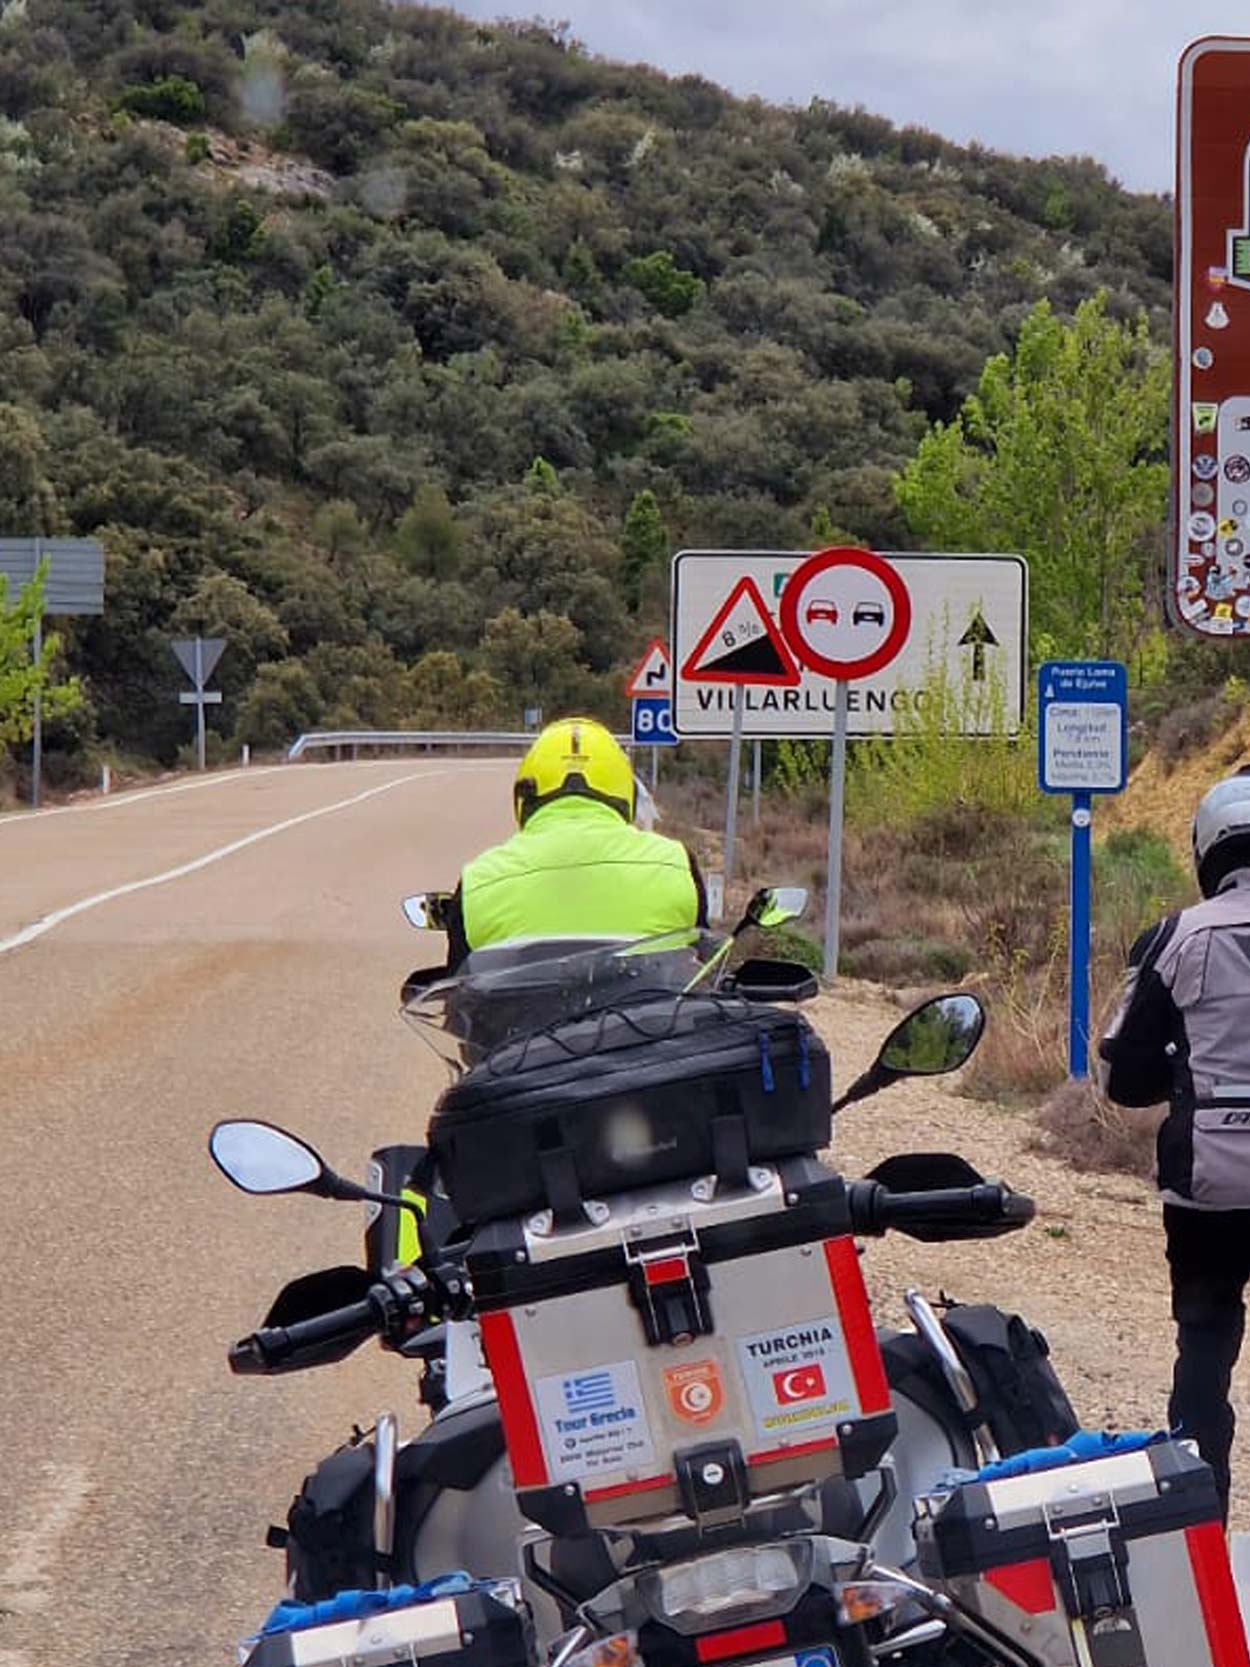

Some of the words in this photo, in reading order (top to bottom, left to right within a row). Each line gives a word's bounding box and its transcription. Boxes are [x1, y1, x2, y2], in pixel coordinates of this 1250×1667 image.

[637, 709, 671, 733] 80
[746, 1327, 833, 1358] TURCHIA
[555, 1416, 587, 1434] Tour
[590, 1406, 636, 1427] Grecia
